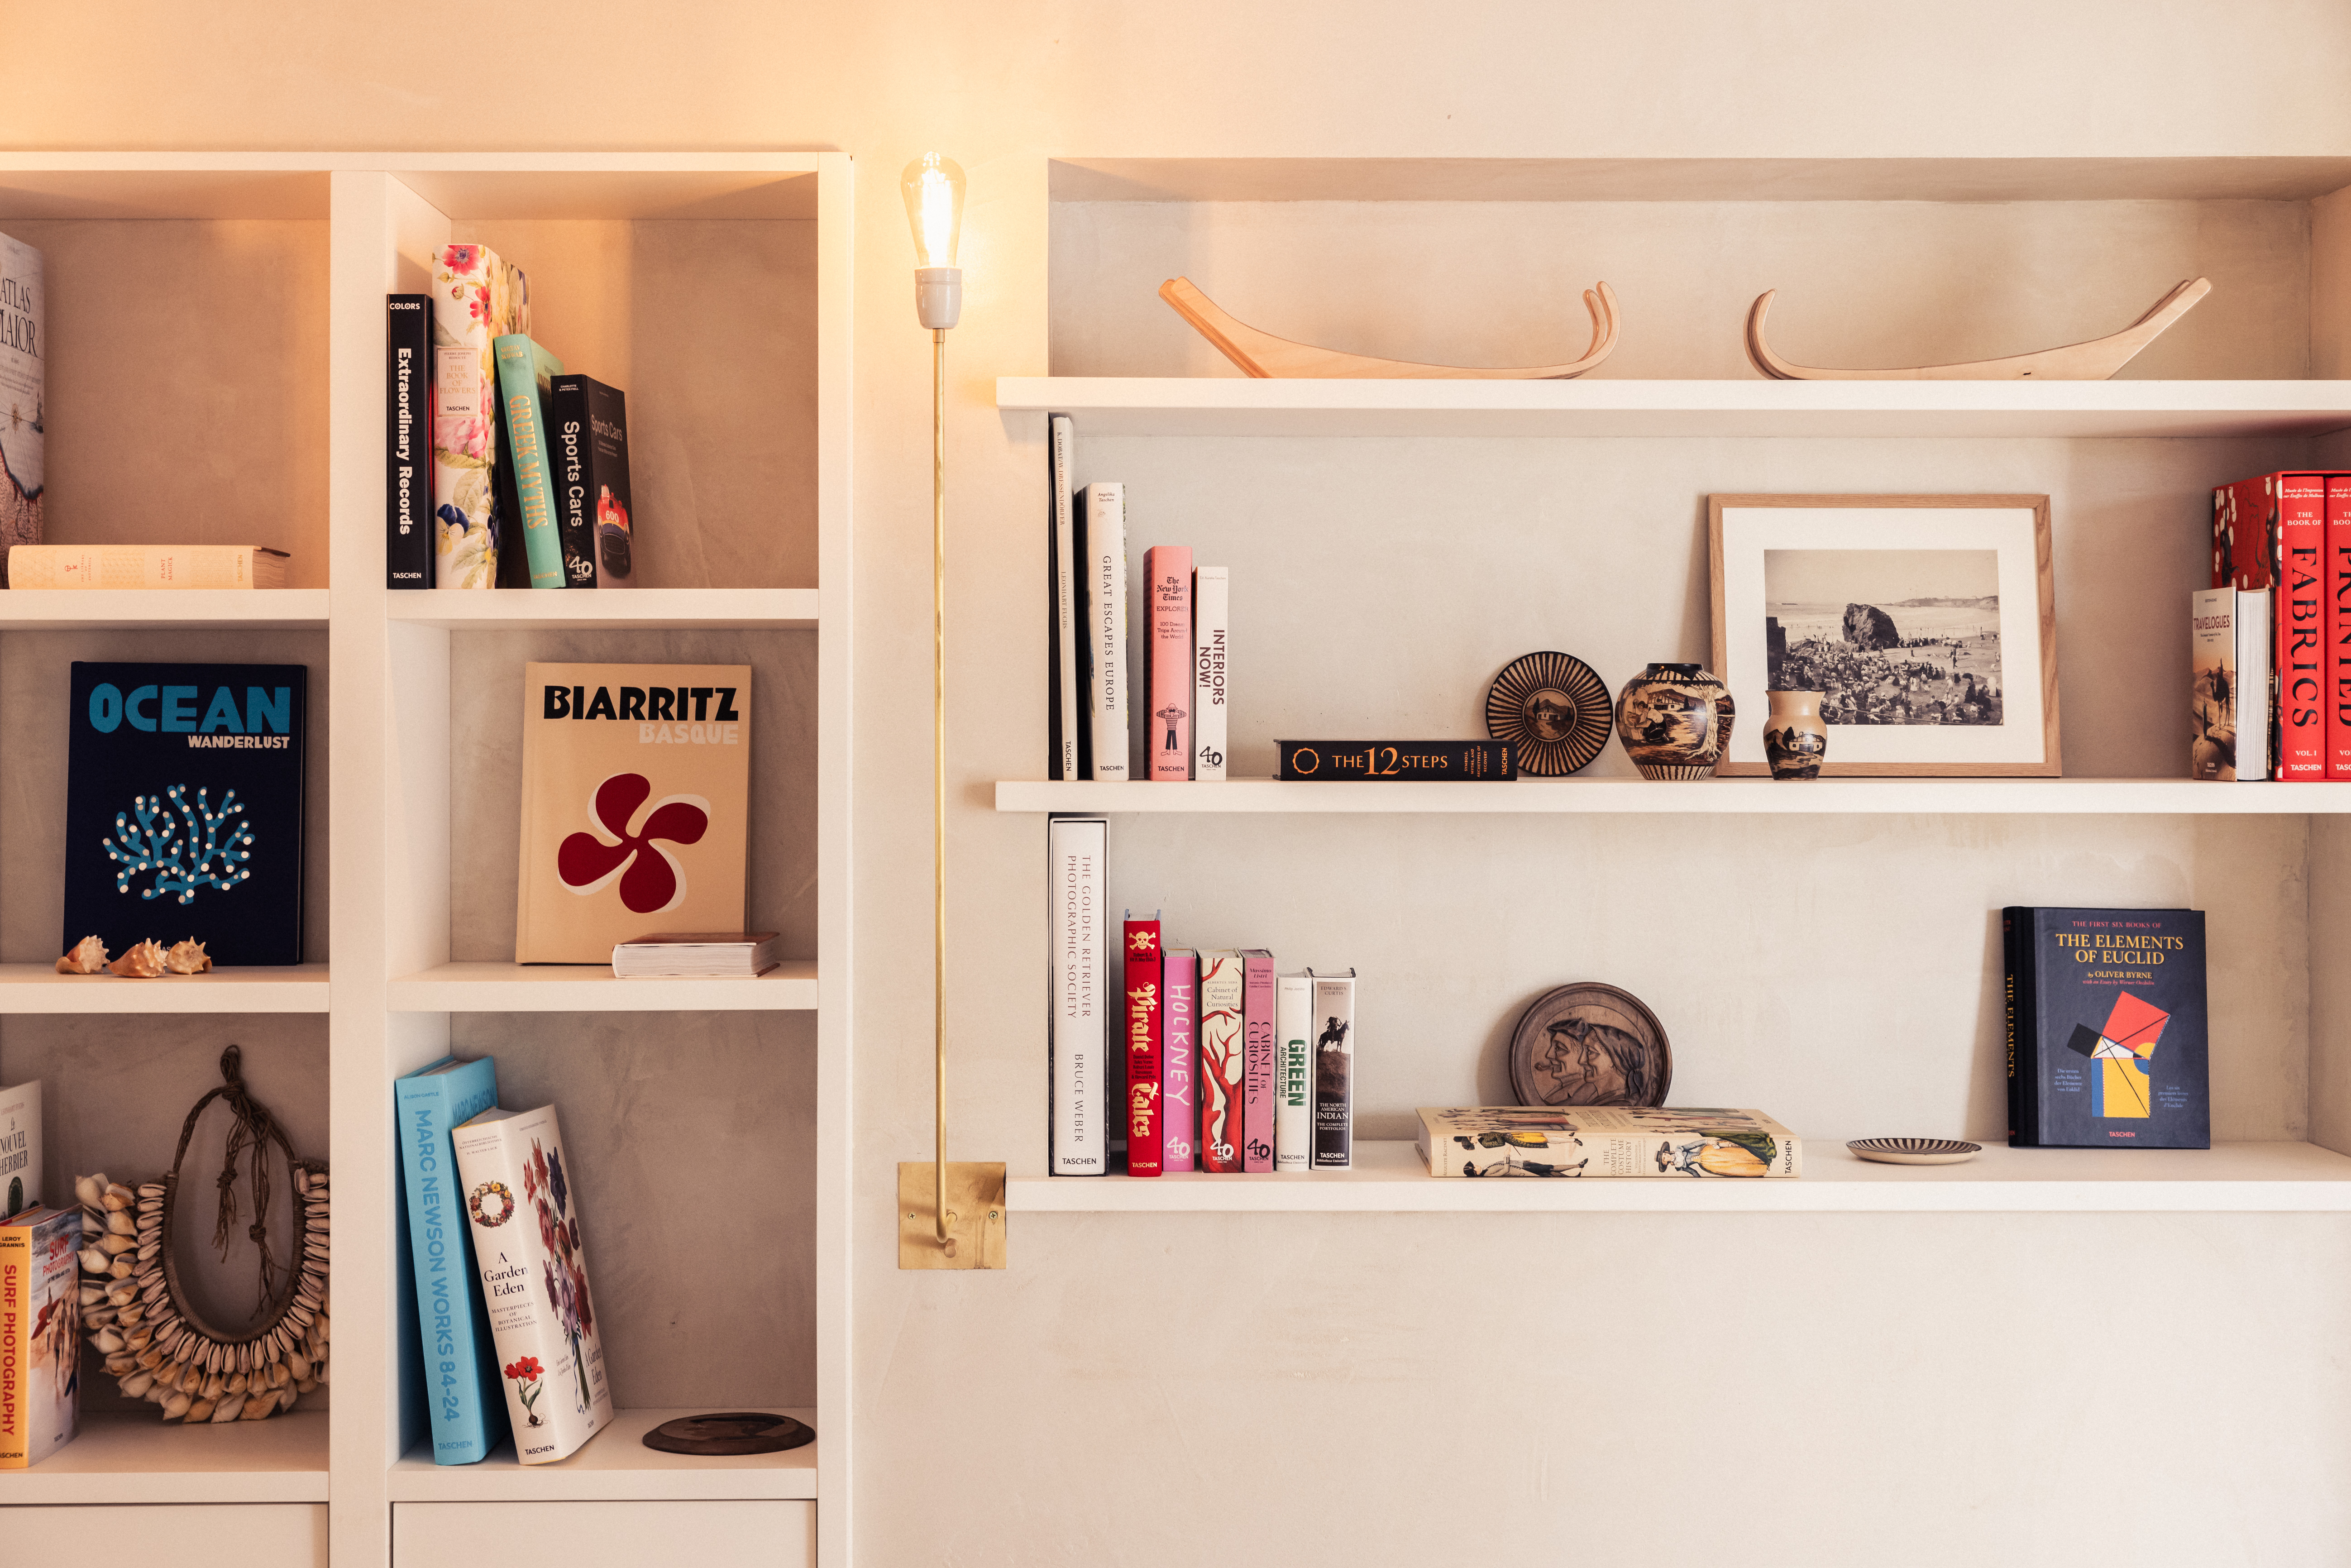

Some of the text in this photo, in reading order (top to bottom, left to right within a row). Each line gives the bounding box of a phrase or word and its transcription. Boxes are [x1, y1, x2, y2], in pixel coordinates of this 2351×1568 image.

[0, 276, 30, 313] ATLAS
[501, 351, 523, 359] SCHWAB
[591, 414, 622, 441] Sports Cars
[397, 348, 413, 535] Extraordinary Records
[510, 395, 548, 529] GREEK MYTHS
[561, 421, 584, 527] Sports Cars
[606, 510, 619, 523] 600
[533, 571, 557, 579] TASCHEN
[569, 556, 593, 575] 40
[1172, 585, 1188, 594] York
[1103, 556, 1114, 710] GREAT ESCAPES EUROPE
[2193, 615, 2230, 631] TRAVELOGUES
[2290, 546, 2318, 727] FABRICS
[1199, 646, 1211, 688] NOW!
[1213, 630, 1225, 705] INTERIORS
[89, 683, 291, 733] OCEAN
[544, 685, 739, 721] BIARRITZ
[188, 735, 290, 749] WANDERLUST
[639, 723, 738, 745] BASQUE
[1199, 746, 1223, 765] 40
[1332, 747, 1448, 775] THE 12 STEPS
[1068, 856, 1076, 1018] PHOTOGRAPHIC SOCIETY
[1082, 855, 1090, 1017] THE GOLDEN RETRIEVER
[2055, 933, 2184, 950] THE ELEMENTS
[2075, 950, 2165, 964] OF EUCLID
[1166, 985, 1191, 1106] HOCKNEY
[1261, 1022, 1271, 1090] CABINET OF
[1127, 981, 1160, 1137] Pirate Tales
[1248, 1022, 1259, 1104] CURIOSITIES
[1288, 1039, 1307, 1106] GREEN
[1075, 1054, 1084, 1142] BRUCE WEBER
[0, 1131, 26, 1155] NOUVEL
[1166, 1136, 1190, 1156] 40
[1210, 1138, 1234, 1158] 40
[1247, 1138, 1271, 1158] 40
[0, 1150, 28, 1176] HERBIER
[50, 1234, 69, 1261] SURF
[498, 1252, 509, 1264] A
[43, 1251, 74, 1276] PHOTOGRAPHY
[415, 1110, 460, 1421] MARC NEWSON WORKS 84-24
[484, 1265, 529, 1282] Garden
[493, 1282, 525, 1297] Eden
[492, 1302, 534, 1314] MASTERPIECES
[498, 1315, 532, 1325] BOTANICAL
[495, 1320, 537, 1332] ILLUSTRATION
[2, 1265, 17, 1436] SURF PHOTOGRAPHY
[438, 1440, 472, 1450] TASCHEN
[525, 1444, 554, 1455] TASCHEN
